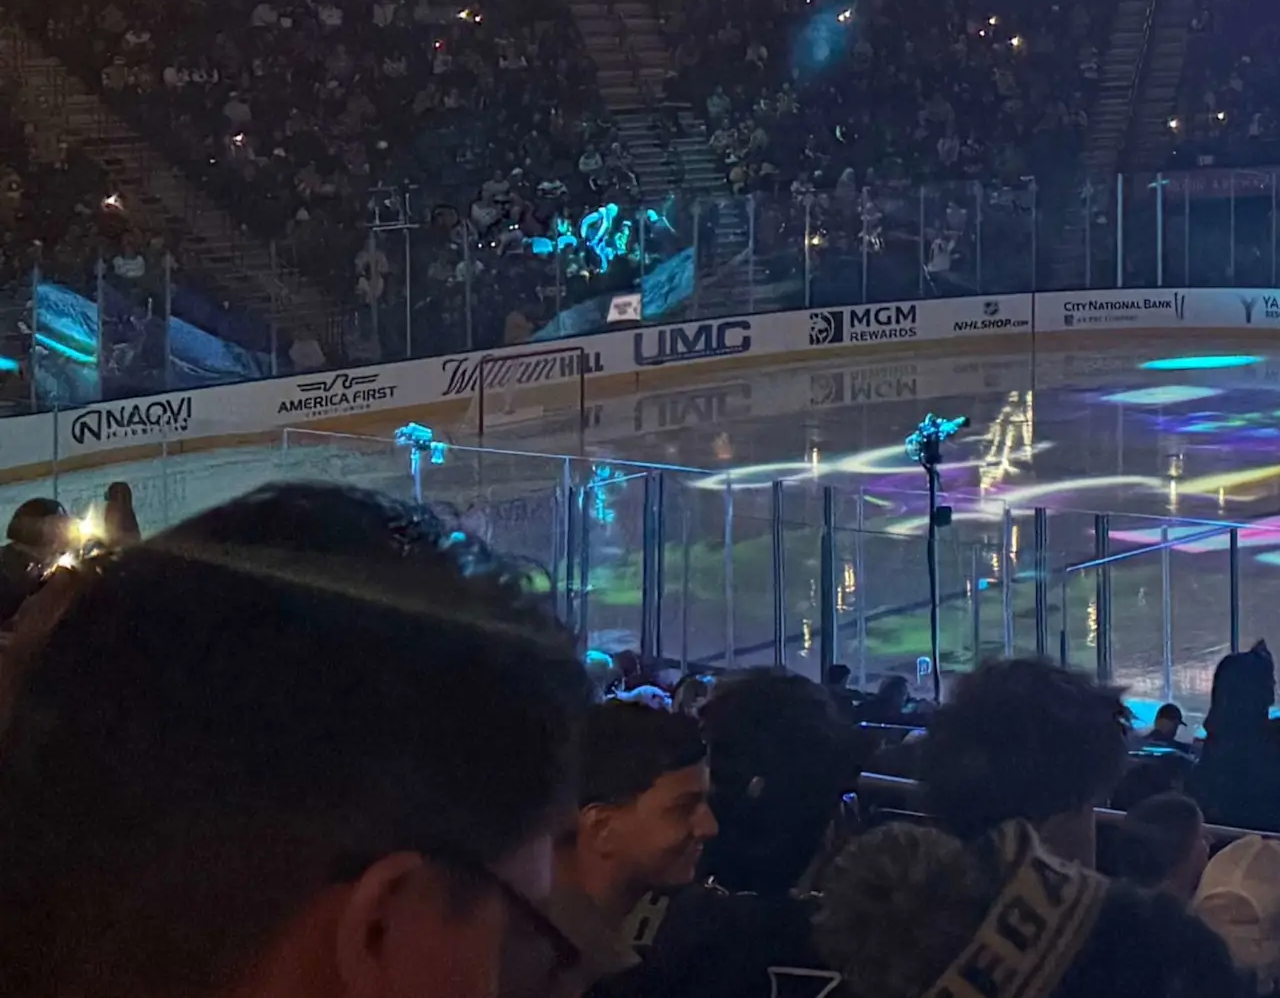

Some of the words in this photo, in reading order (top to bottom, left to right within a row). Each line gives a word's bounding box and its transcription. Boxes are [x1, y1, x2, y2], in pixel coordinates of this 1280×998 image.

[849, 304, 917, 328] MGM
[1089, 299, 1142, 311] NATIONAL
[1143, 298, 1172, 310] BANK
[634, 321, 751, 366] UMC
[849, 327, 917, 342] REWARDS
[559, 352, 604, 378] HILL
[277, 392, 350, 414] AMERICA
[352, 385, 397, 404] FIRST
[106, 396, 192, 432] NAQVI
